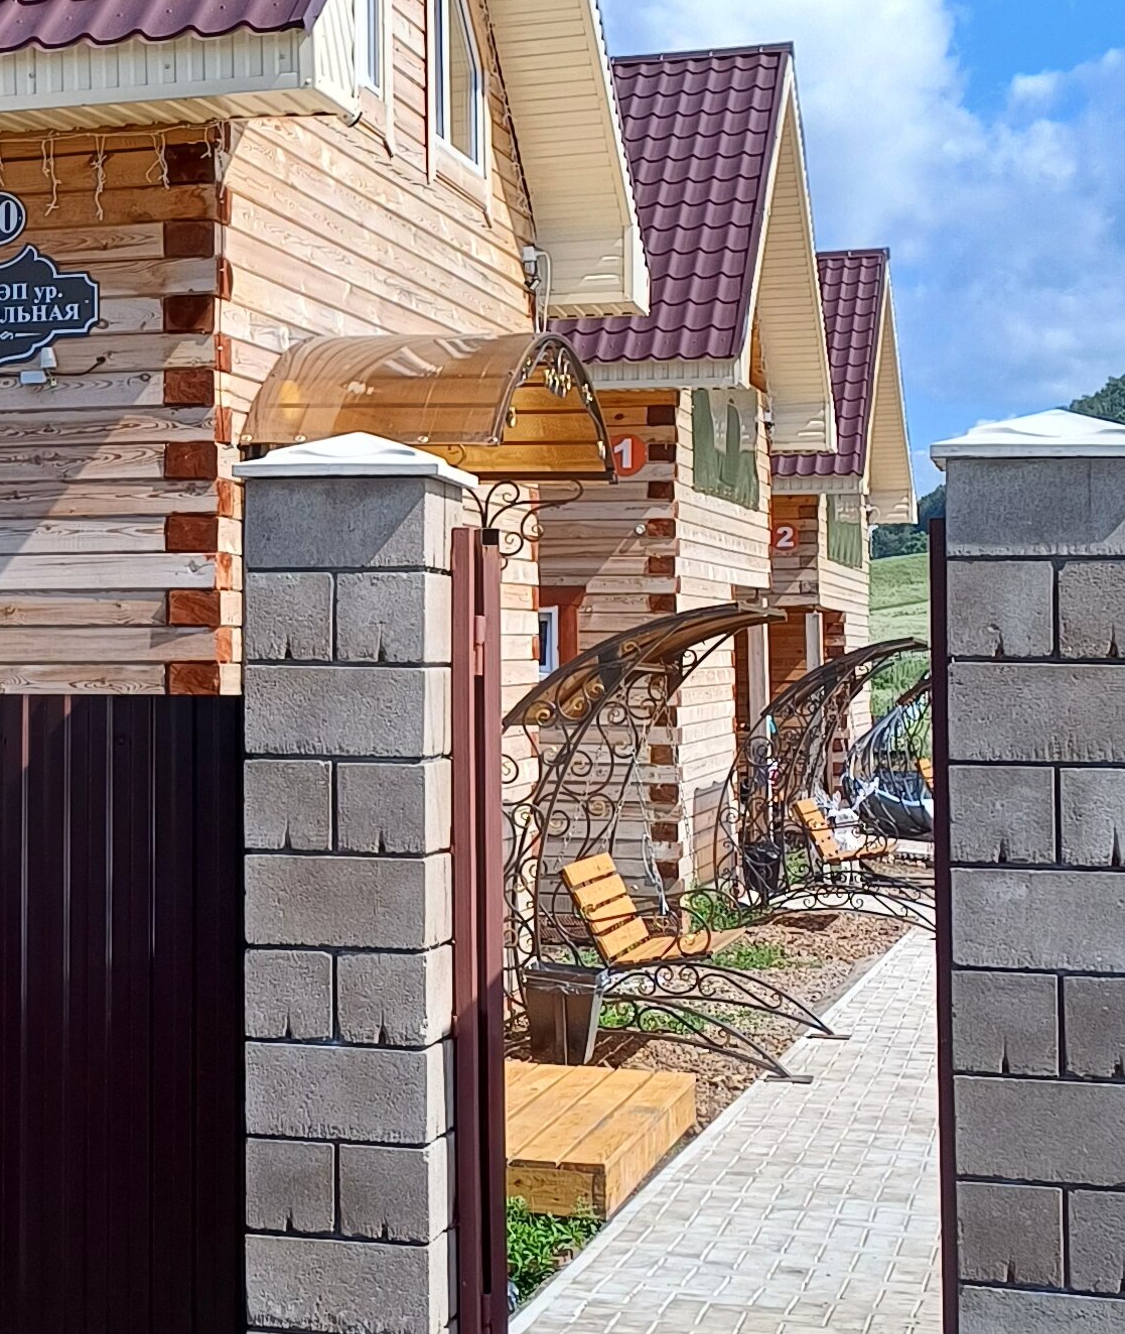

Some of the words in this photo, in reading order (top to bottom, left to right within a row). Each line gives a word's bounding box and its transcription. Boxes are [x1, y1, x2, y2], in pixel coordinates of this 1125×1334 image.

[33, 286, 64, 304] ур.
[614, 437, 632, 469] 1
[776, 526, 794, 547] 2
